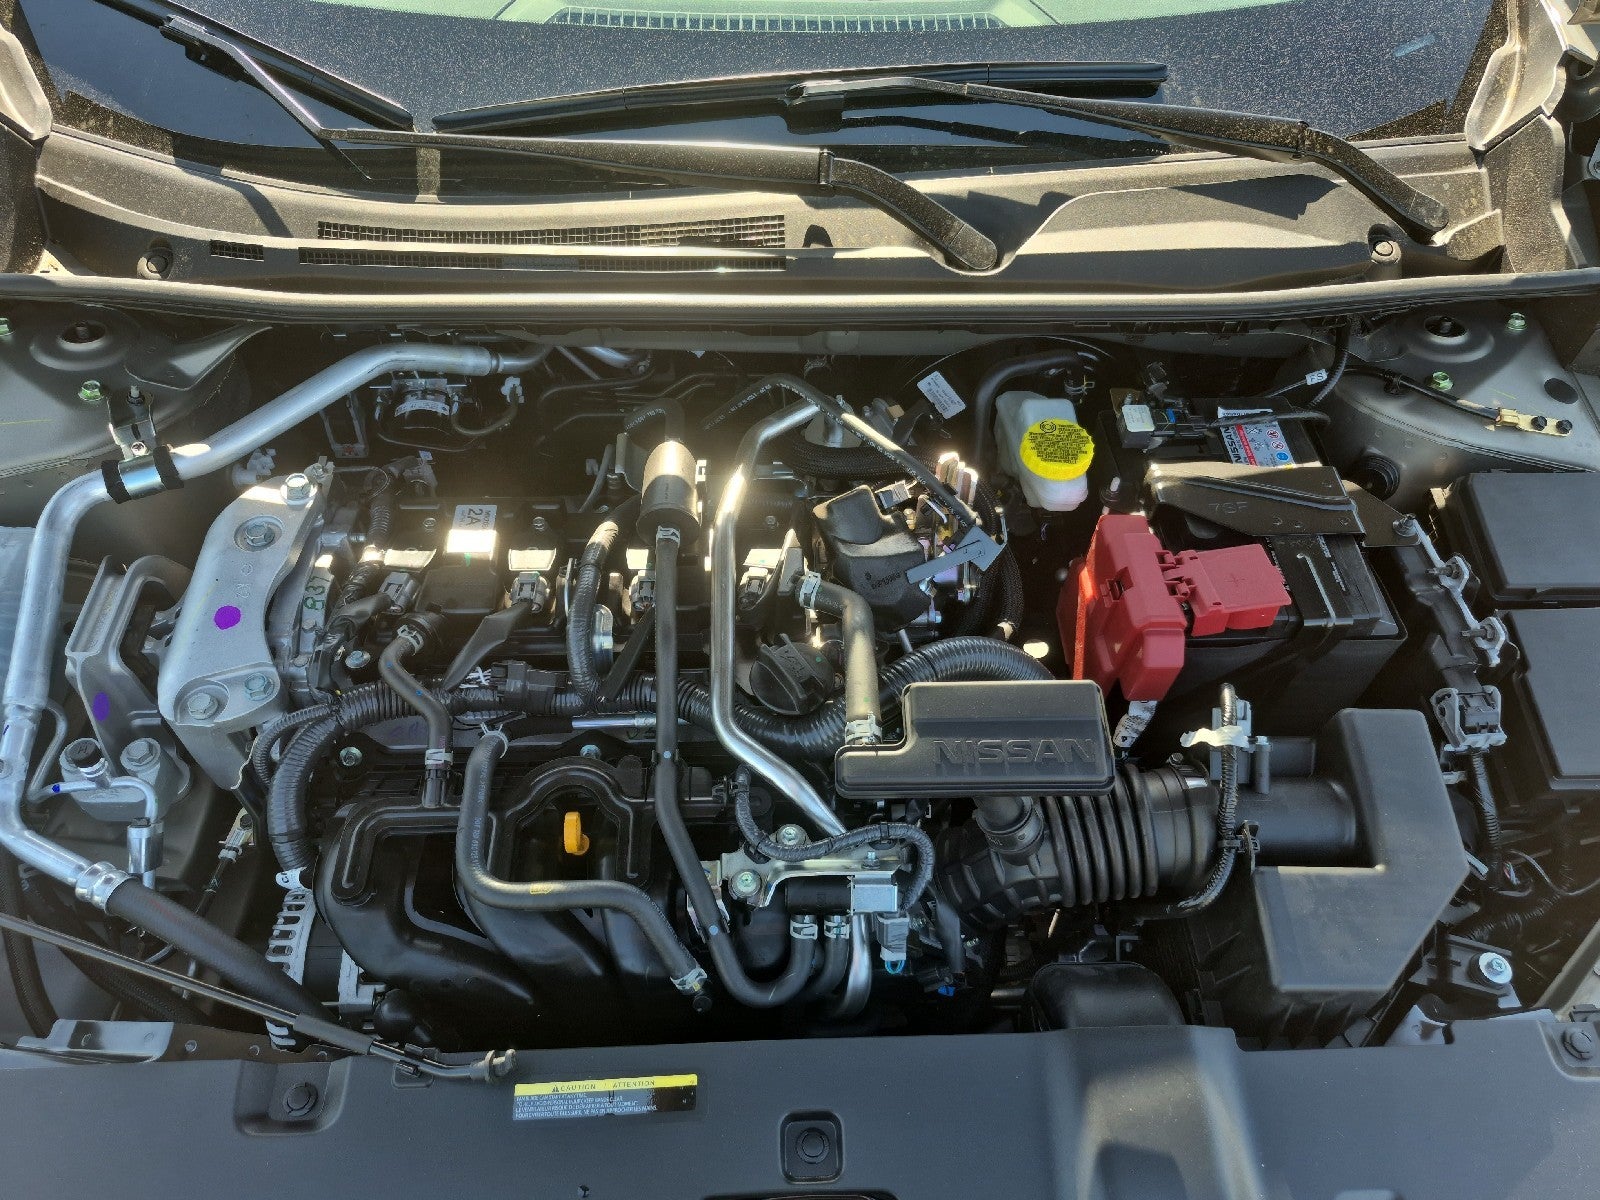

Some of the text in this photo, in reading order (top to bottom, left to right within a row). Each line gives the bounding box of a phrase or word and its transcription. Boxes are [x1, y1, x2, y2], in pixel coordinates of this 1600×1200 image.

[1309, 372, 1324, 383] FS
[1223, 425, 1242, 463] NISSAN
[466, 508, 484, 527] 2A
[932, 738, 1096, 764] NISSAN
[560, 1083, 597, 1092] CAUTION
[612, 1079, 655, 1089] ATTENTION
